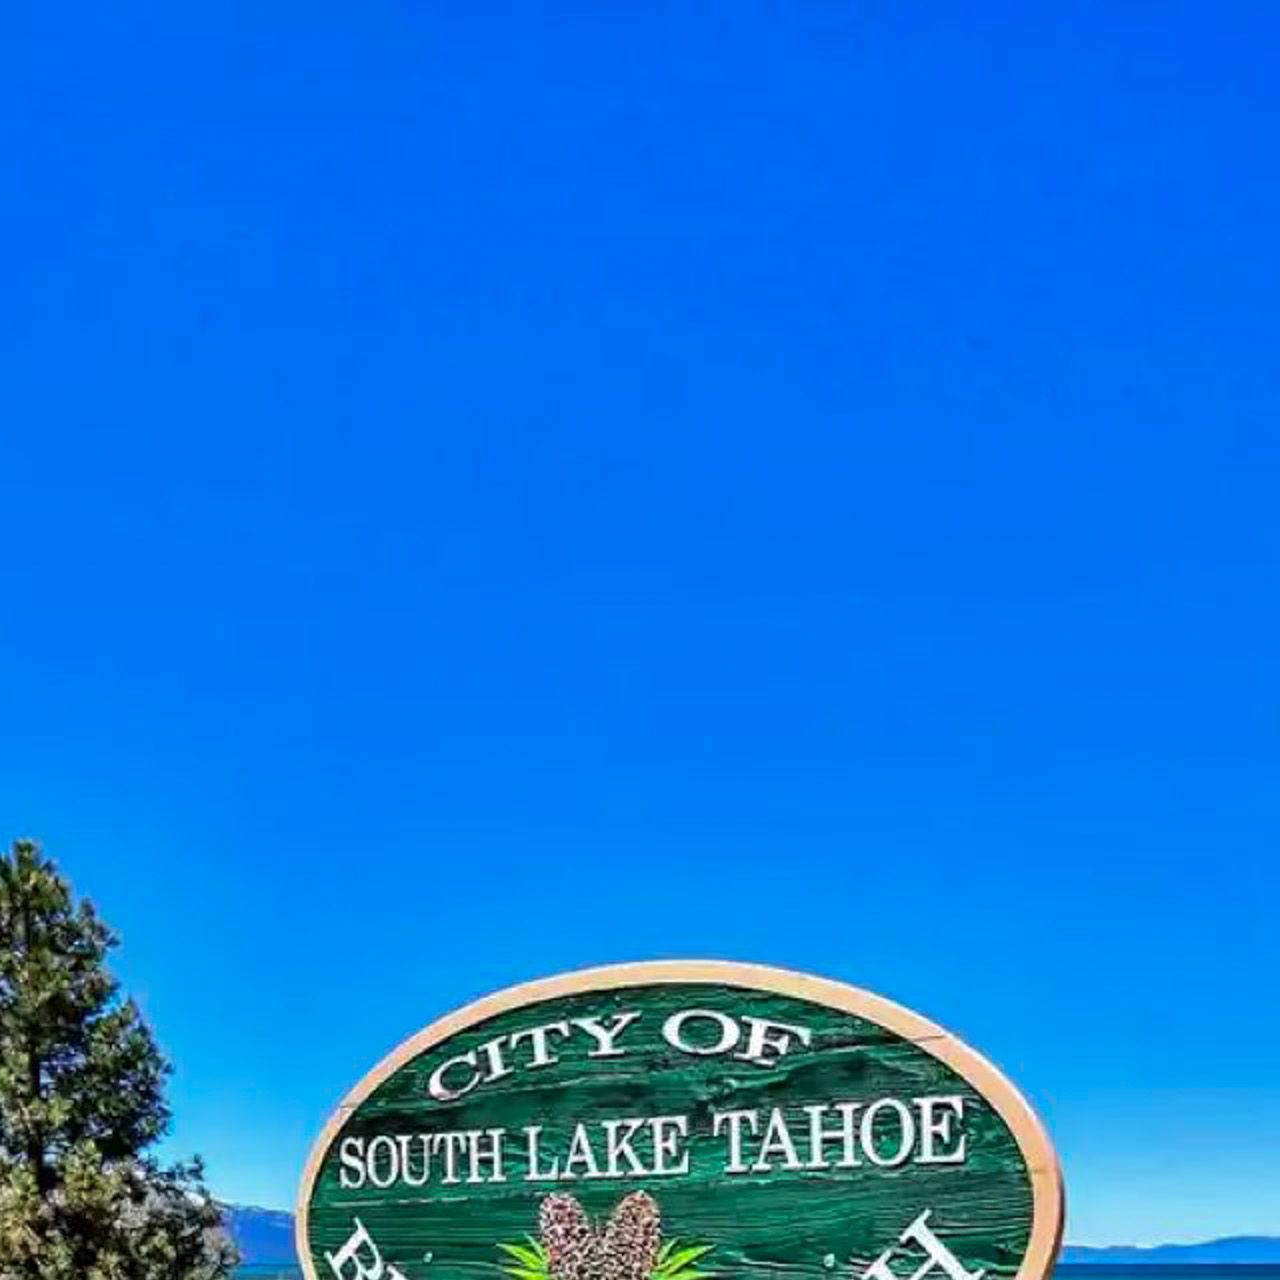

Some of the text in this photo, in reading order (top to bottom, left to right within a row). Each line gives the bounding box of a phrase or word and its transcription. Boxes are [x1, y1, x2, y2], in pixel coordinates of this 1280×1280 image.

[429, 1008, 812, 1101] CITY OF
[339, 1096, 968, 1189] SOUTH LAKE TAHOE
